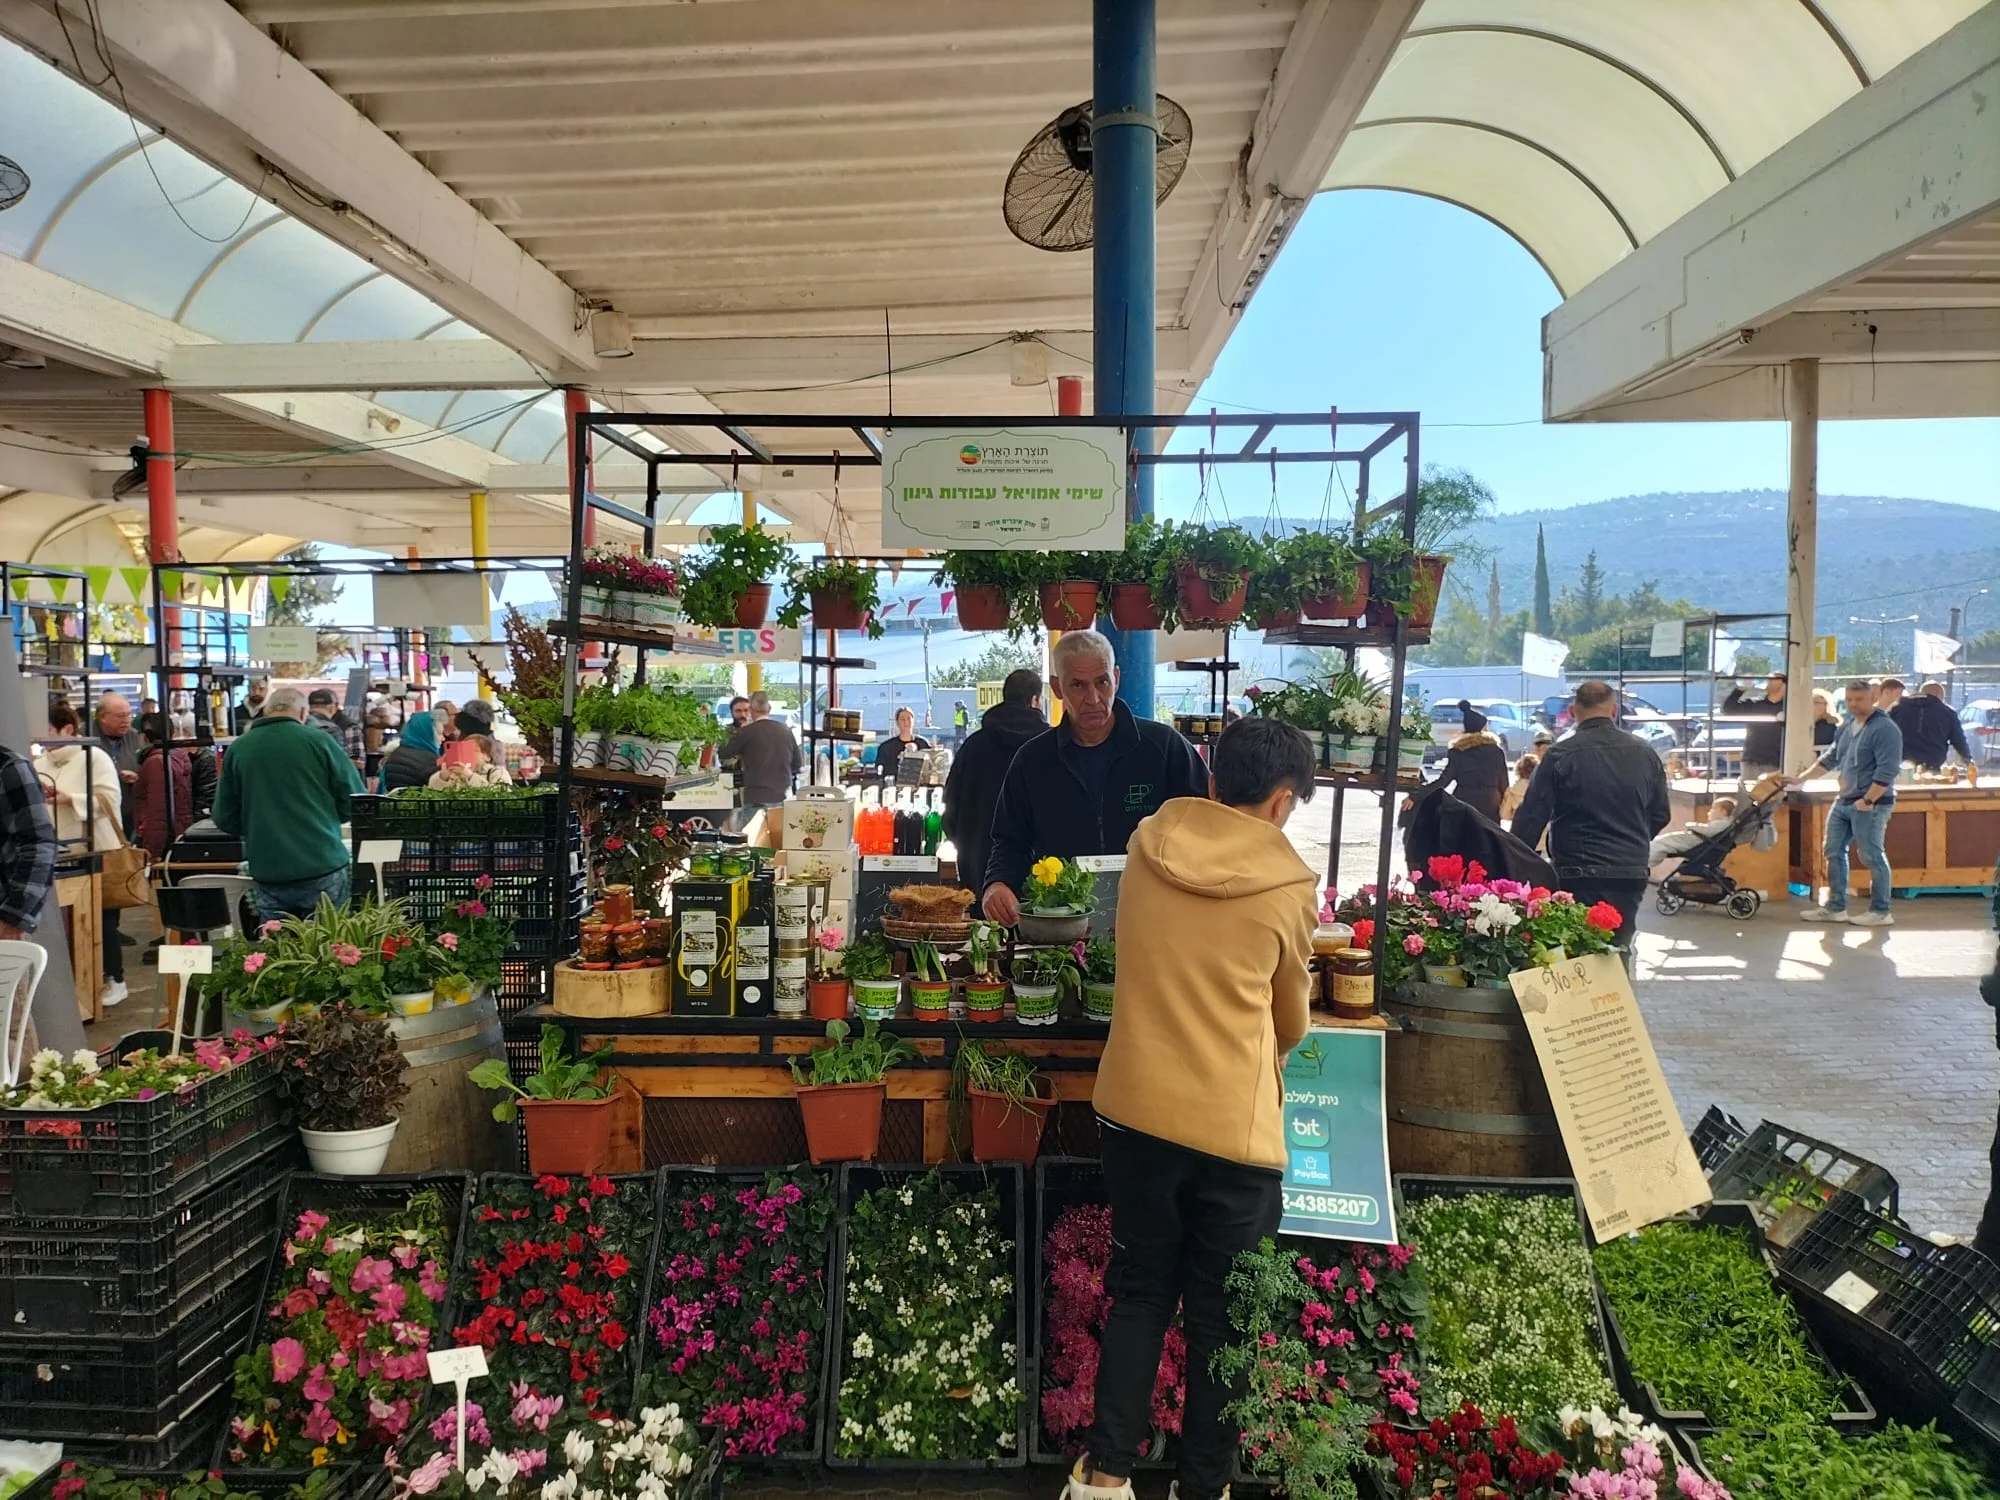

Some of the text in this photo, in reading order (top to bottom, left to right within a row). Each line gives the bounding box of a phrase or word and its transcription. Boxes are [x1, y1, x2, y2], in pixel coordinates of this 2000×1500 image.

[903, 487, 933, 502] גינון
[939, 487, 997, 500] עבודות
[1066, 487, 1104, 500] שימי
[1284, 1090, 1339, 1107] ניתן לשלם
[1293, 1168, 1329, 1181] PayBox
